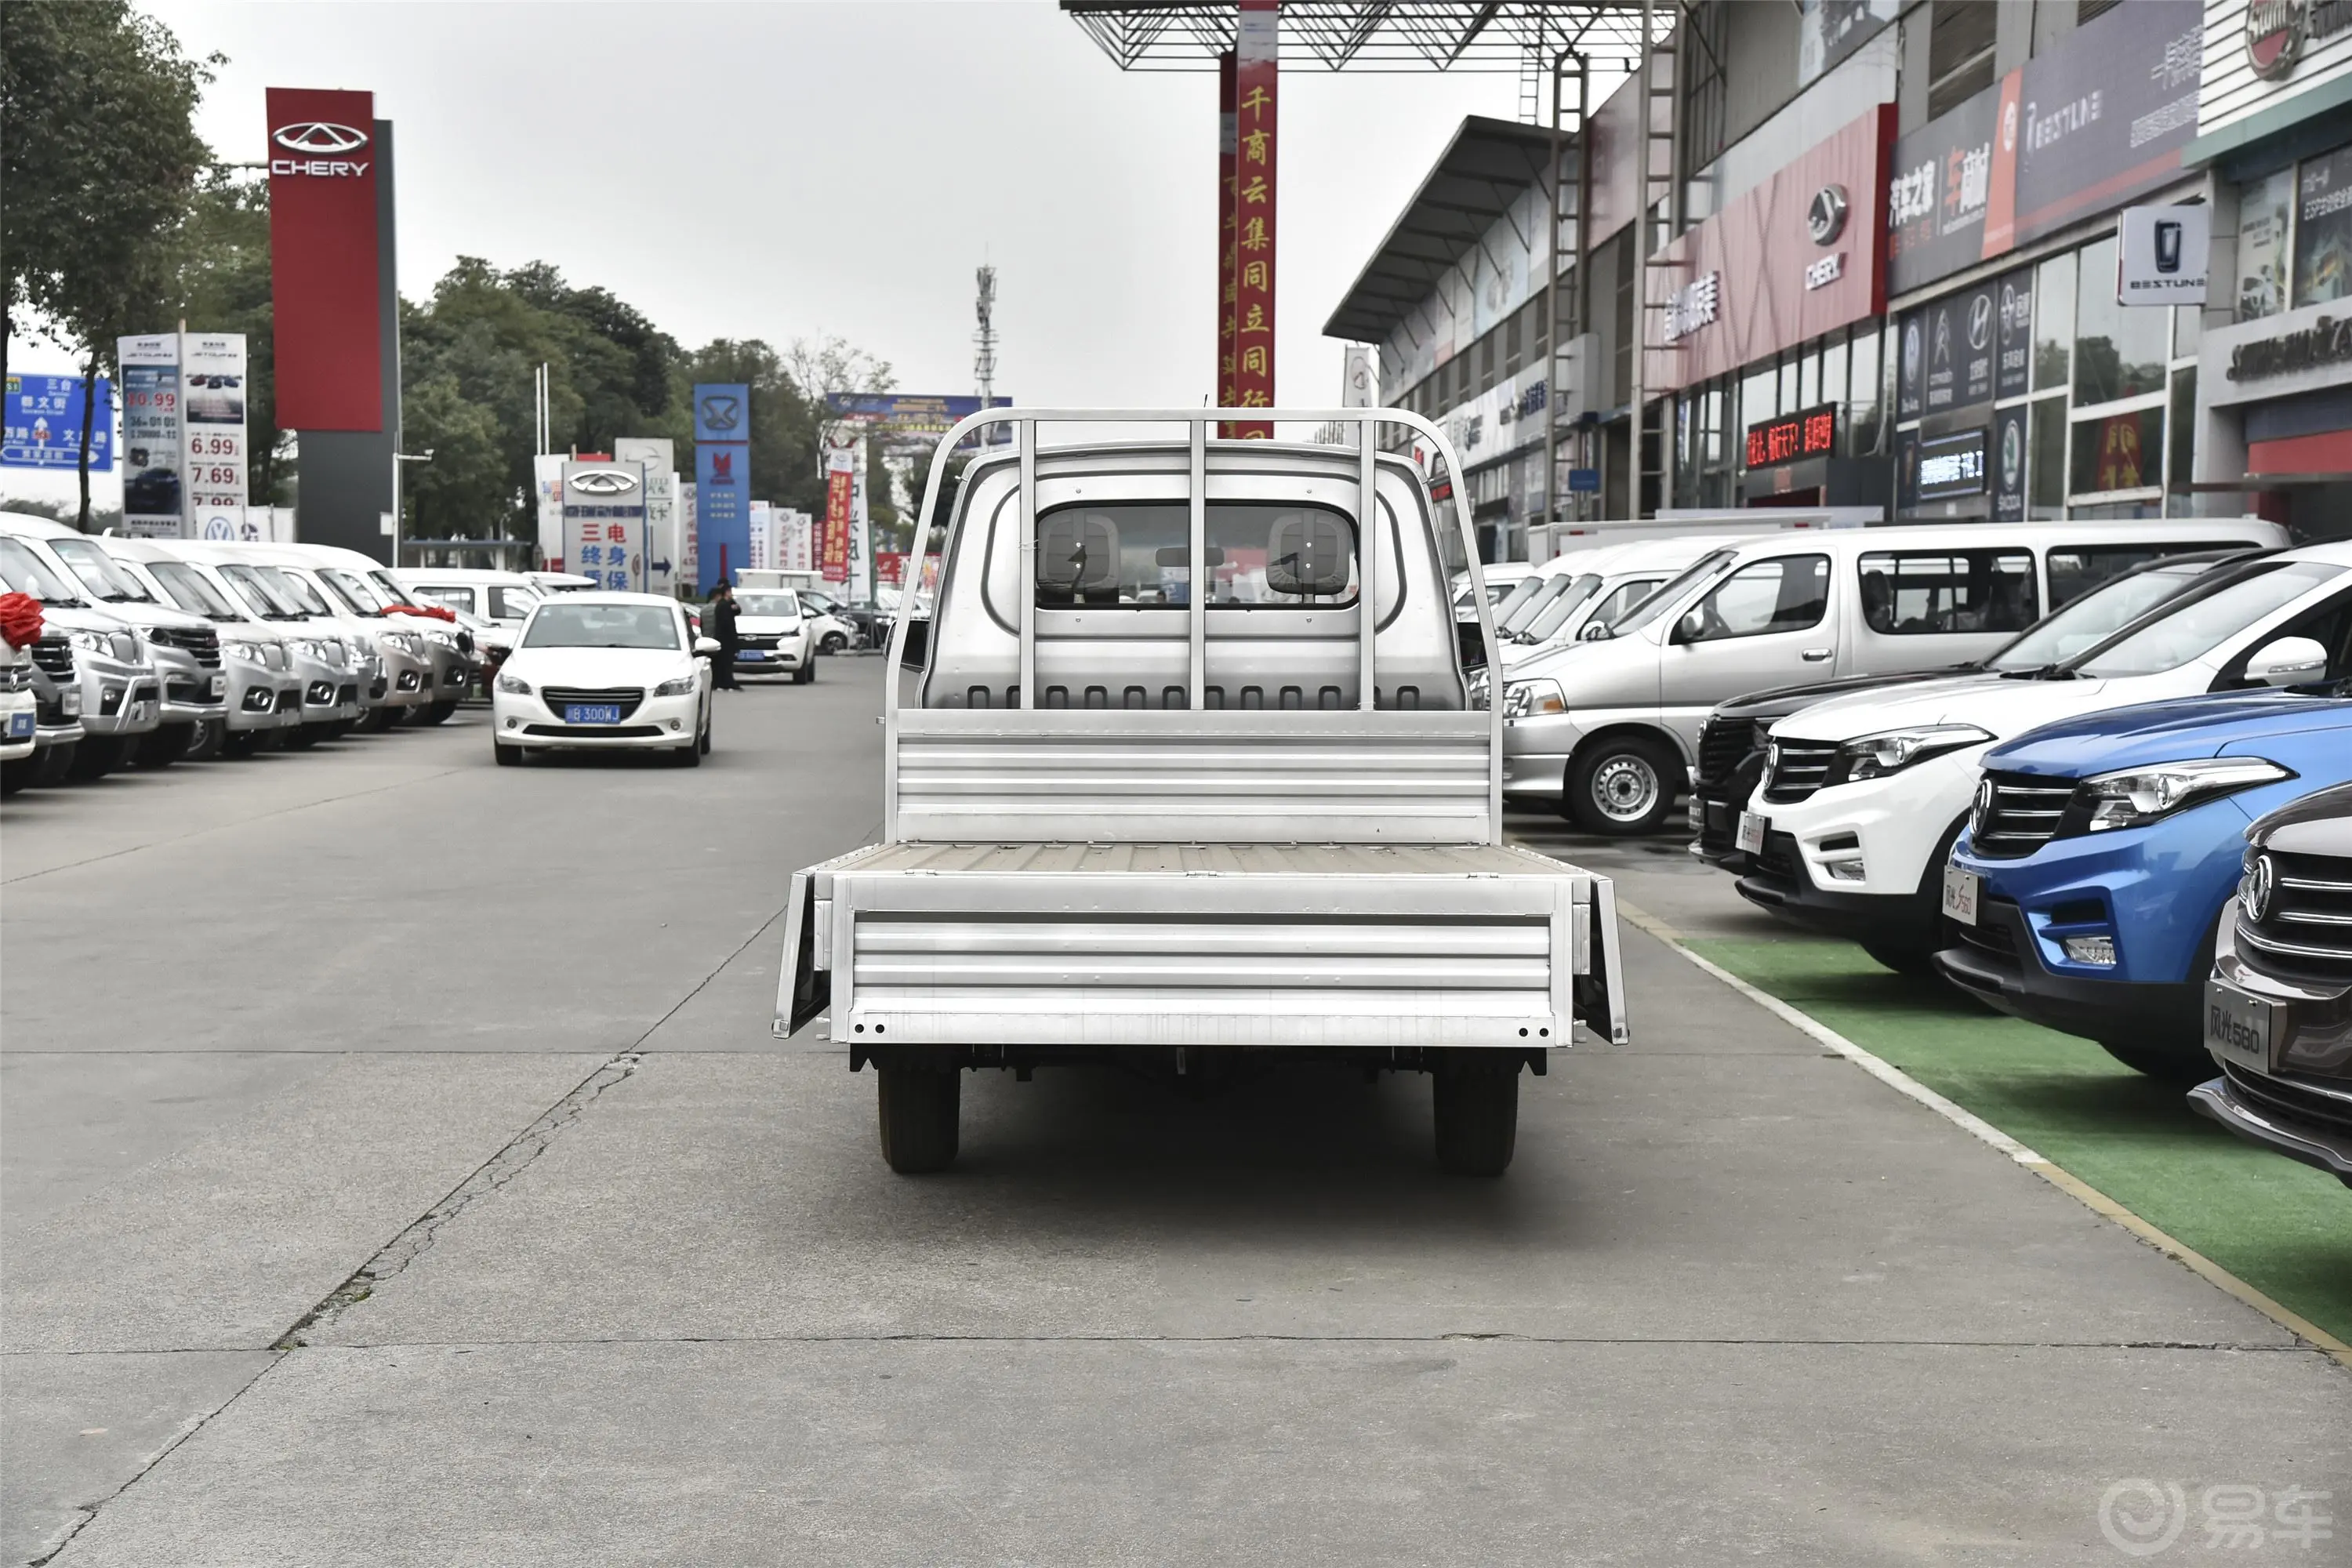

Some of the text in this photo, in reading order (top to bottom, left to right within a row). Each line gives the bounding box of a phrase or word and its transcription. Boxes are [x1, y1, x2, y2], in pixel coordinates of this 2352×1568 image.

[271, 159, 369, 177] CHERY
[2130, 278, 2205, 290] BESTUNE
[191, 437, 233, 456] 6.99
[191, 466, 234, 485] 7.69
[580, 522, 626, 543] 三电
[580, 545, 627, 567] 终身
[2210, 1005, 2260, 1055] 风光580
